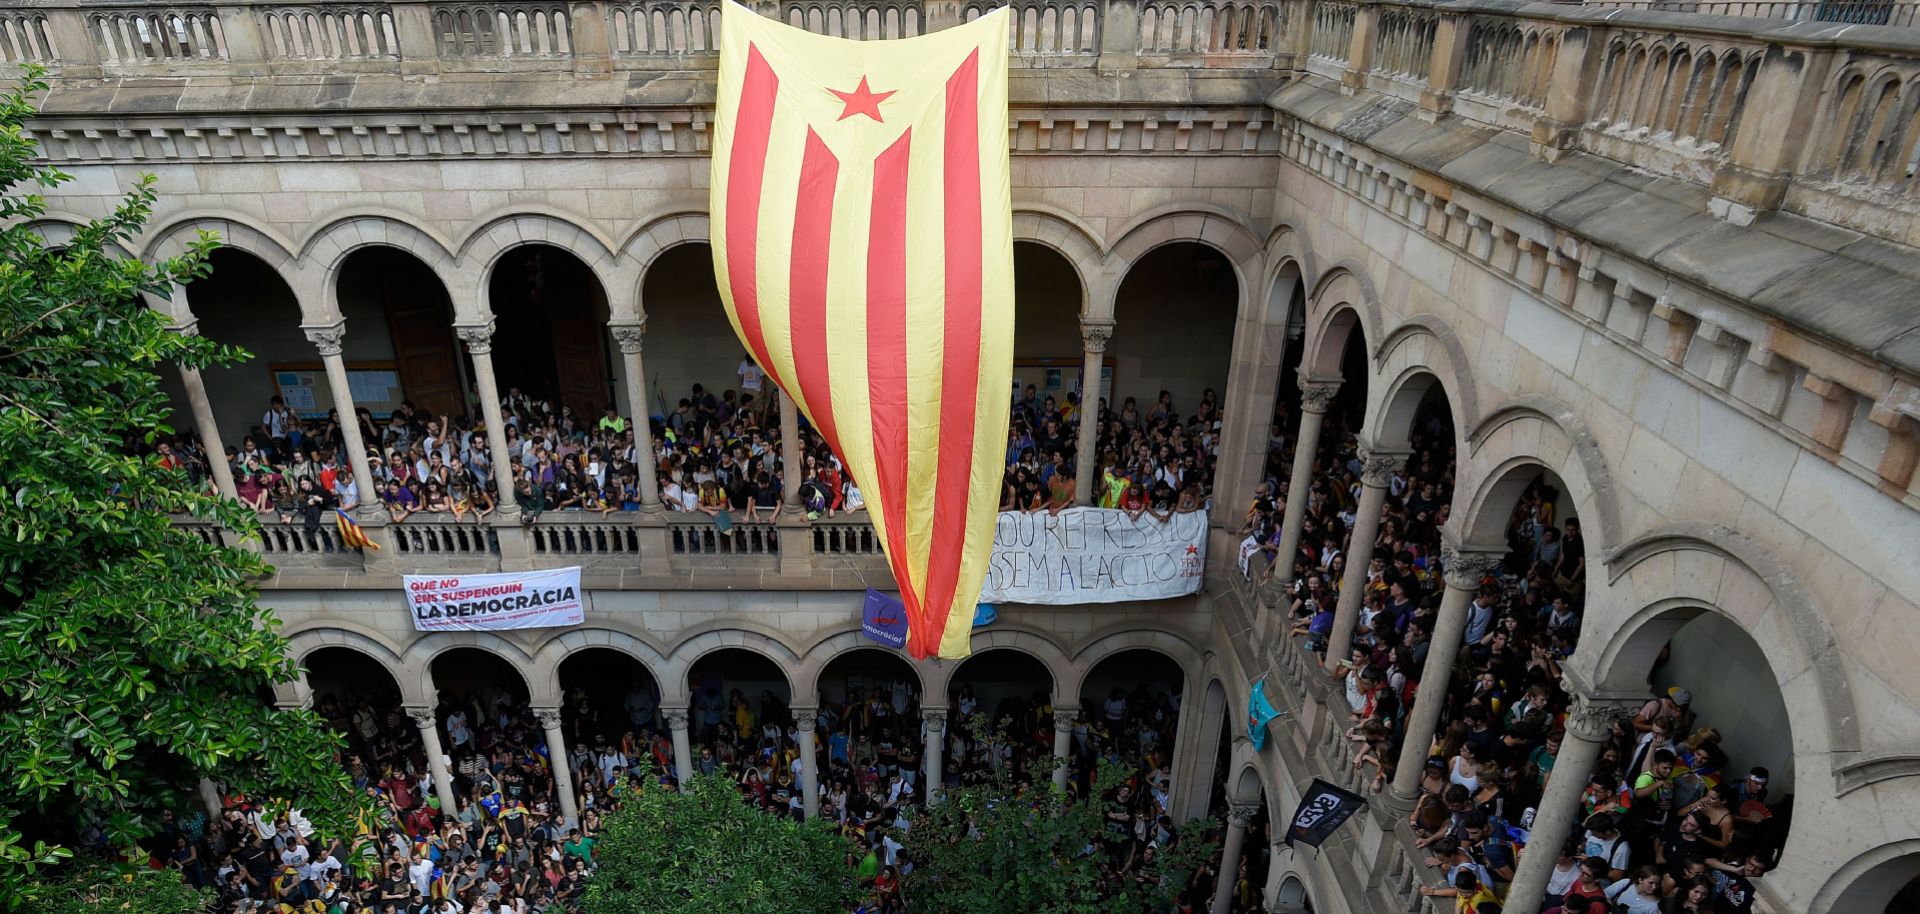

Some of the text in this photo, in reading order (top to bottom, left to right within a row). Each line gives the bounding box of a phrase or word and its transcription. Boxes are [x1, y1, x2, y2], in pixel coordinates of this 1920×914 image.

[410, 578, 460, 592] QUE NO
[1059, 554, 1075, 592] A
[415, 583, 523, 604] ENS SUSPENGUIN
[416, 605, 442, 620] LA
[445, 586, 576, 618] DEMOCRÀCIA
